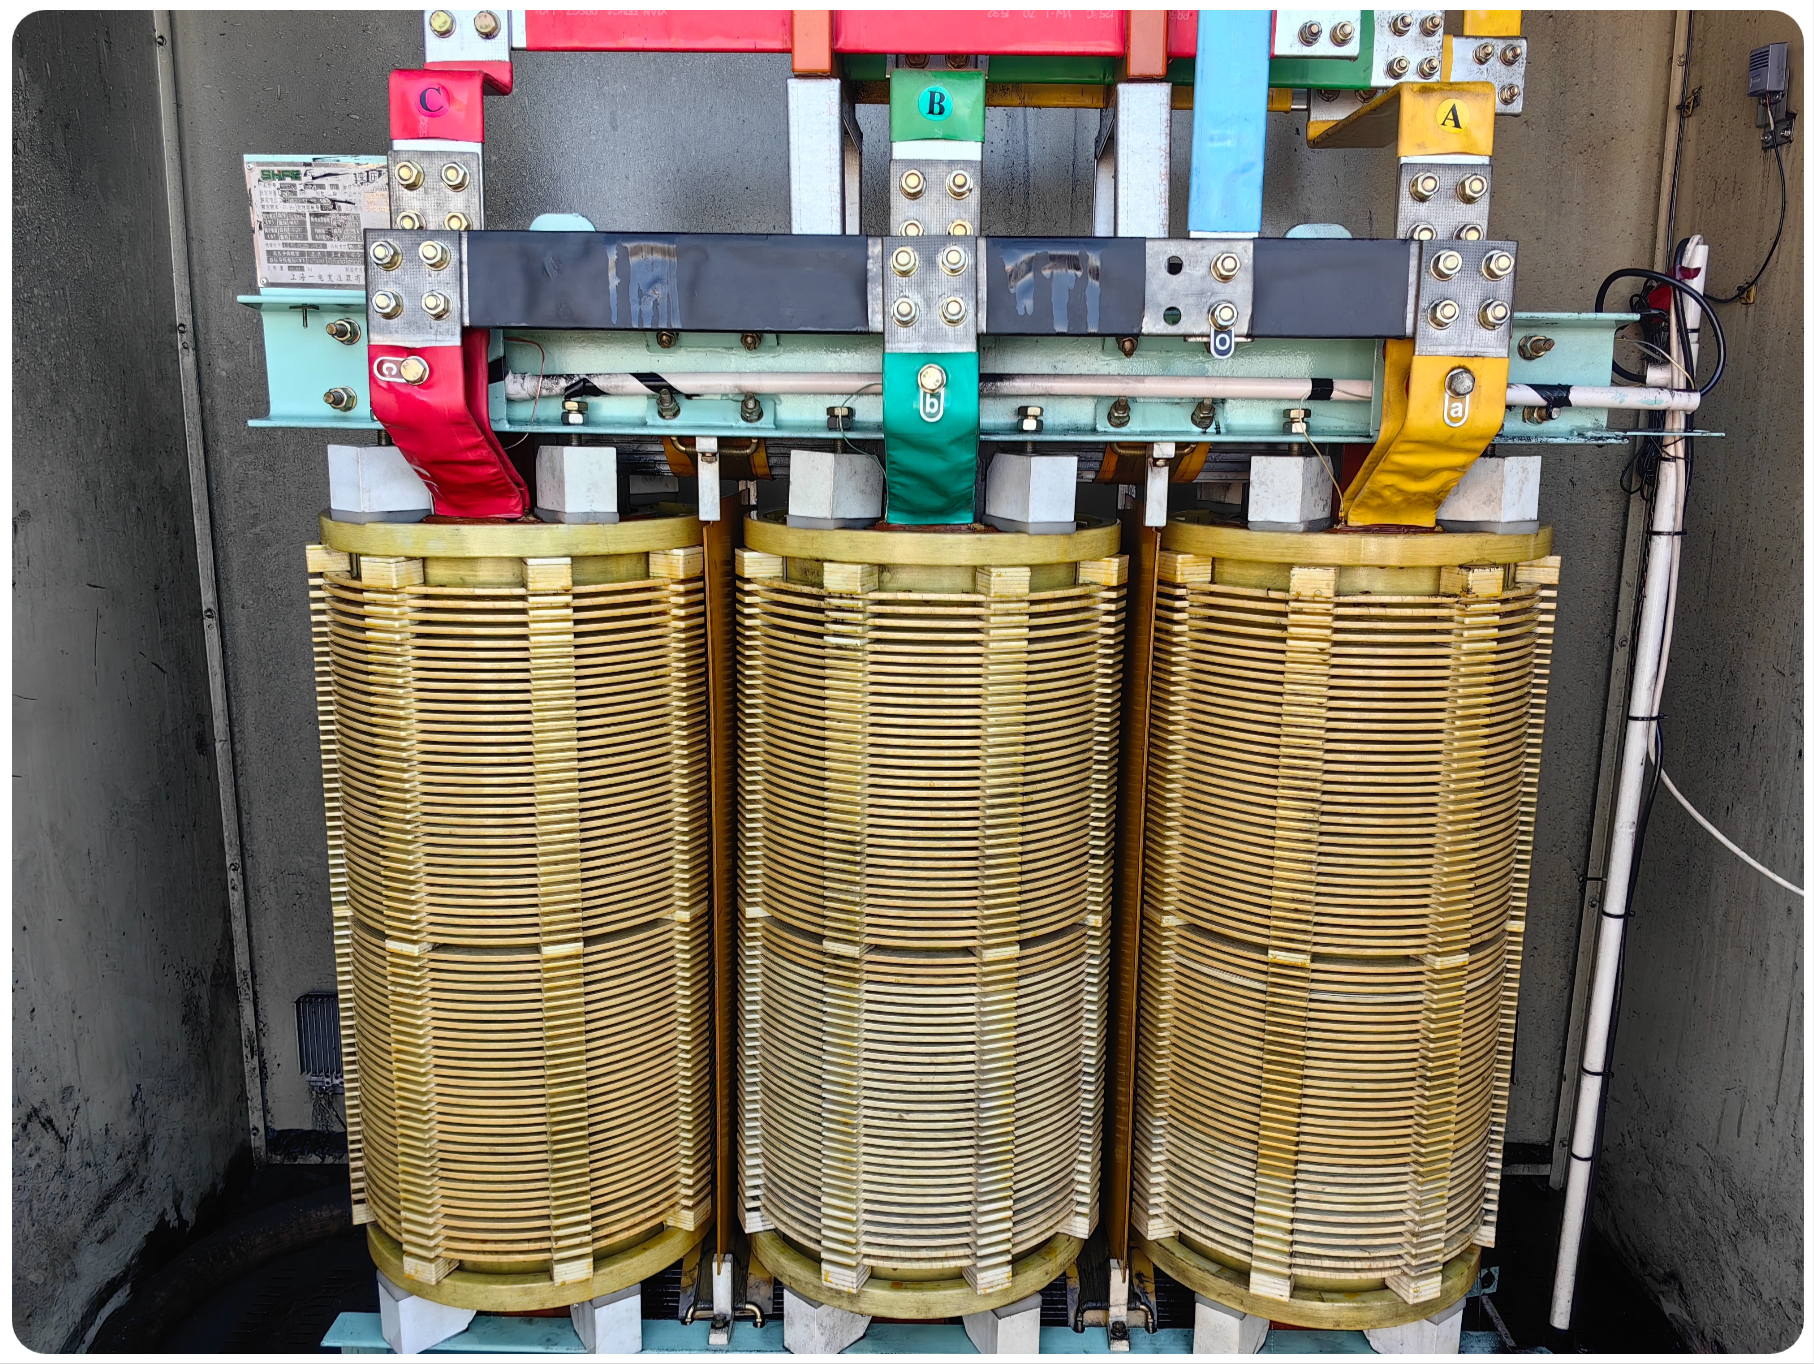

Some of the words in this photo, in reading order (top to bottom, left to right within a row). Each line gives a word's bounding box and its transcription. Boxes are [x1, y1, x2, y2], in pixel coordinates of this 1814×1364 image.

[420, 87, 443, 113] C
[926, 90, 946, 116] B
[1440, 103, 1463, 129] A
[926, 393, 939, 414] b
[1449, 402, 1463, 418] a
